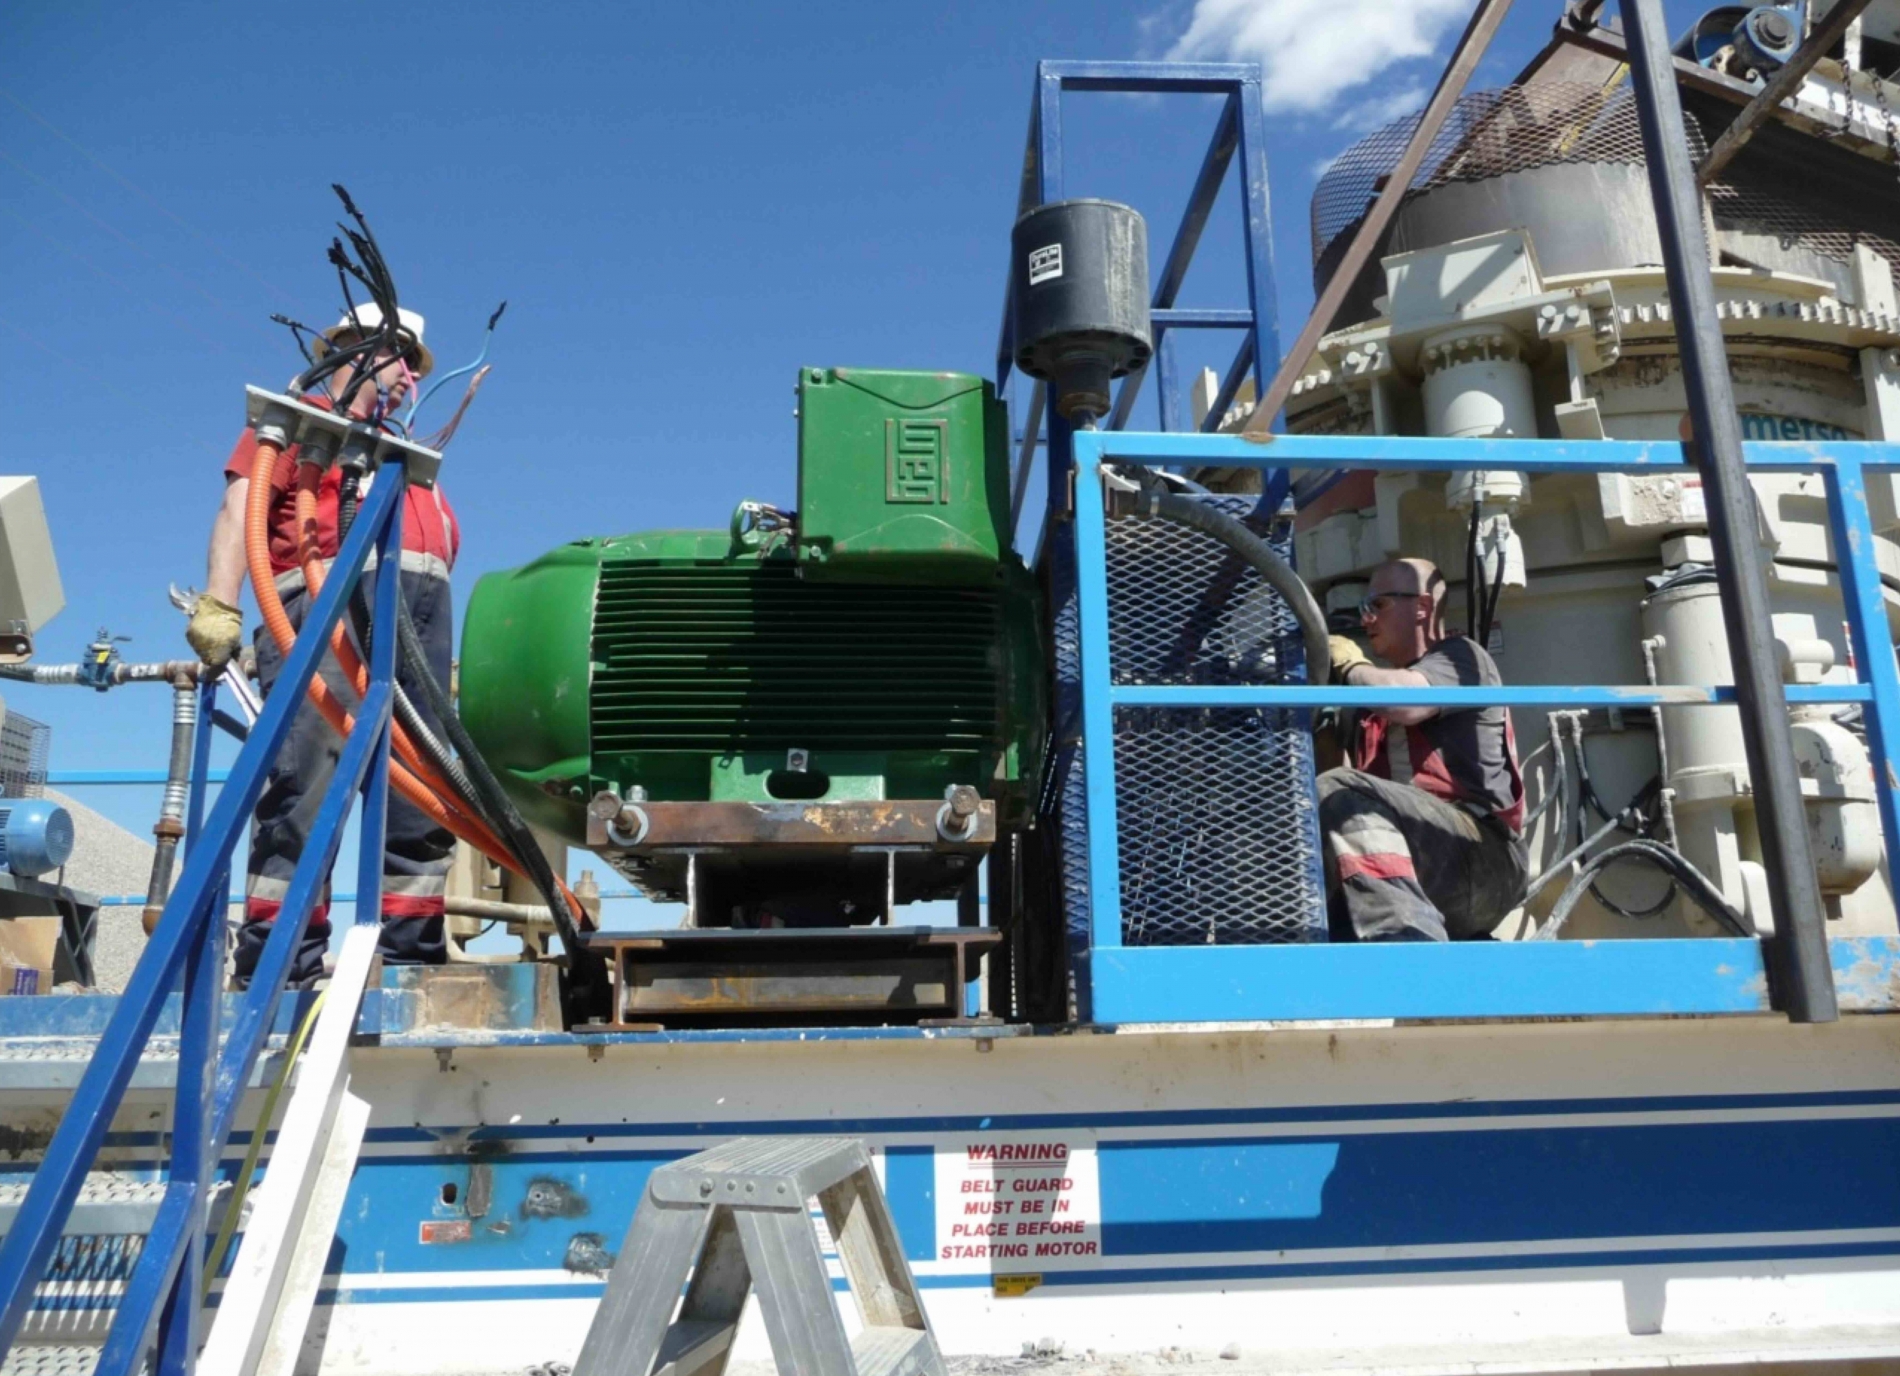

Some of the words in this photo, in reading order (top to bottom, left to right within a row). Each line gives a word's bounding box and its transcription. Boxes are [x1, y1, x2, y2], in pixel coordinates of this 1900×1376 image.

[967, 1143, 1067, 1160] WARNING
[960, 1179, 1005, 1193] BELT
[1012, 1178, 1073, 1192] GUARD
[964, 1201, 1014, 1215] MUST
[1021, 1200, 1044, 1214] BE
[1051, 1199, 1070, 1213] IN
[952, 1222, 1009, 1237] PLACE
[1016, 1220, 1085, 1235] BEFORE
[941, 1243, 1028, 1259] STARTING
[1035, 1241, 1097, 1256] MOTOR
